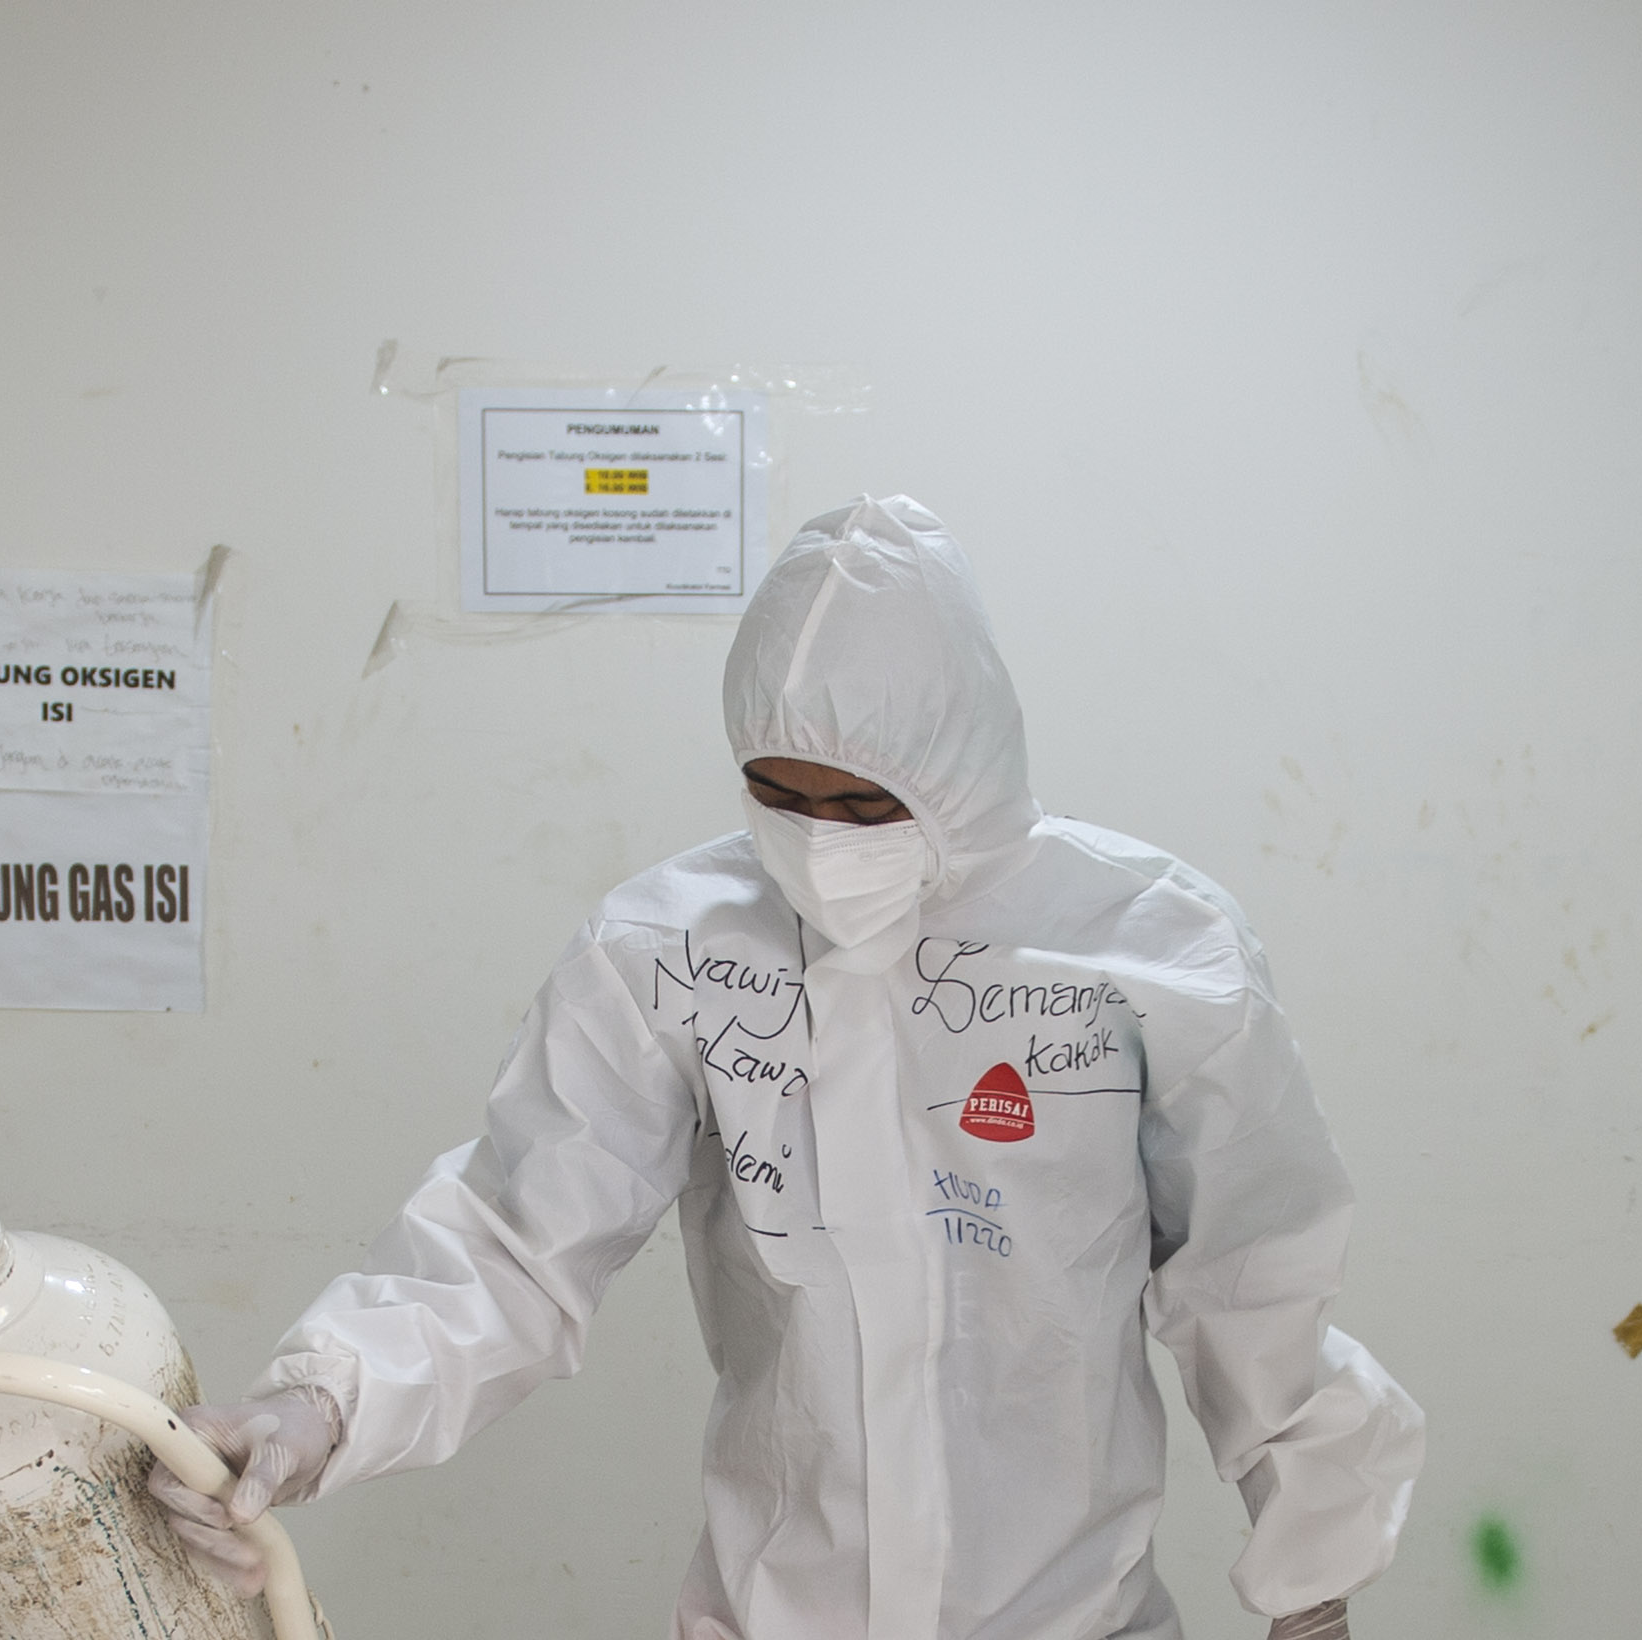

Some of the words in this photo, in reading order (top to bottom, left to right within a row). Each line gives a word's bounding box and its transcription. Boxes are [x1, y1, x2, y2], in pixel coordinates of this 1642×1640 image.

[566, 423, 660, 436] PENGUMUMAN
[549, 450, 585, 463] Tabung
[587, 451, 627, 464] Oksigen
[527, 508, 560, 519] tabung
[563, 508, 600, 519] oksigen
[602, 508, 638, 520] kosong
[546, 521, 569, 532] yang
[626, 520, 652, 531] untuk
[60, 666, 176, 691] OKSIGEN
[41, 701, 73, 723] ISI
[67, 862, 136, 924] GAS
[144, 863, 190, 924] ISI
[969, 1097, 1029, 1118] PERISAI
